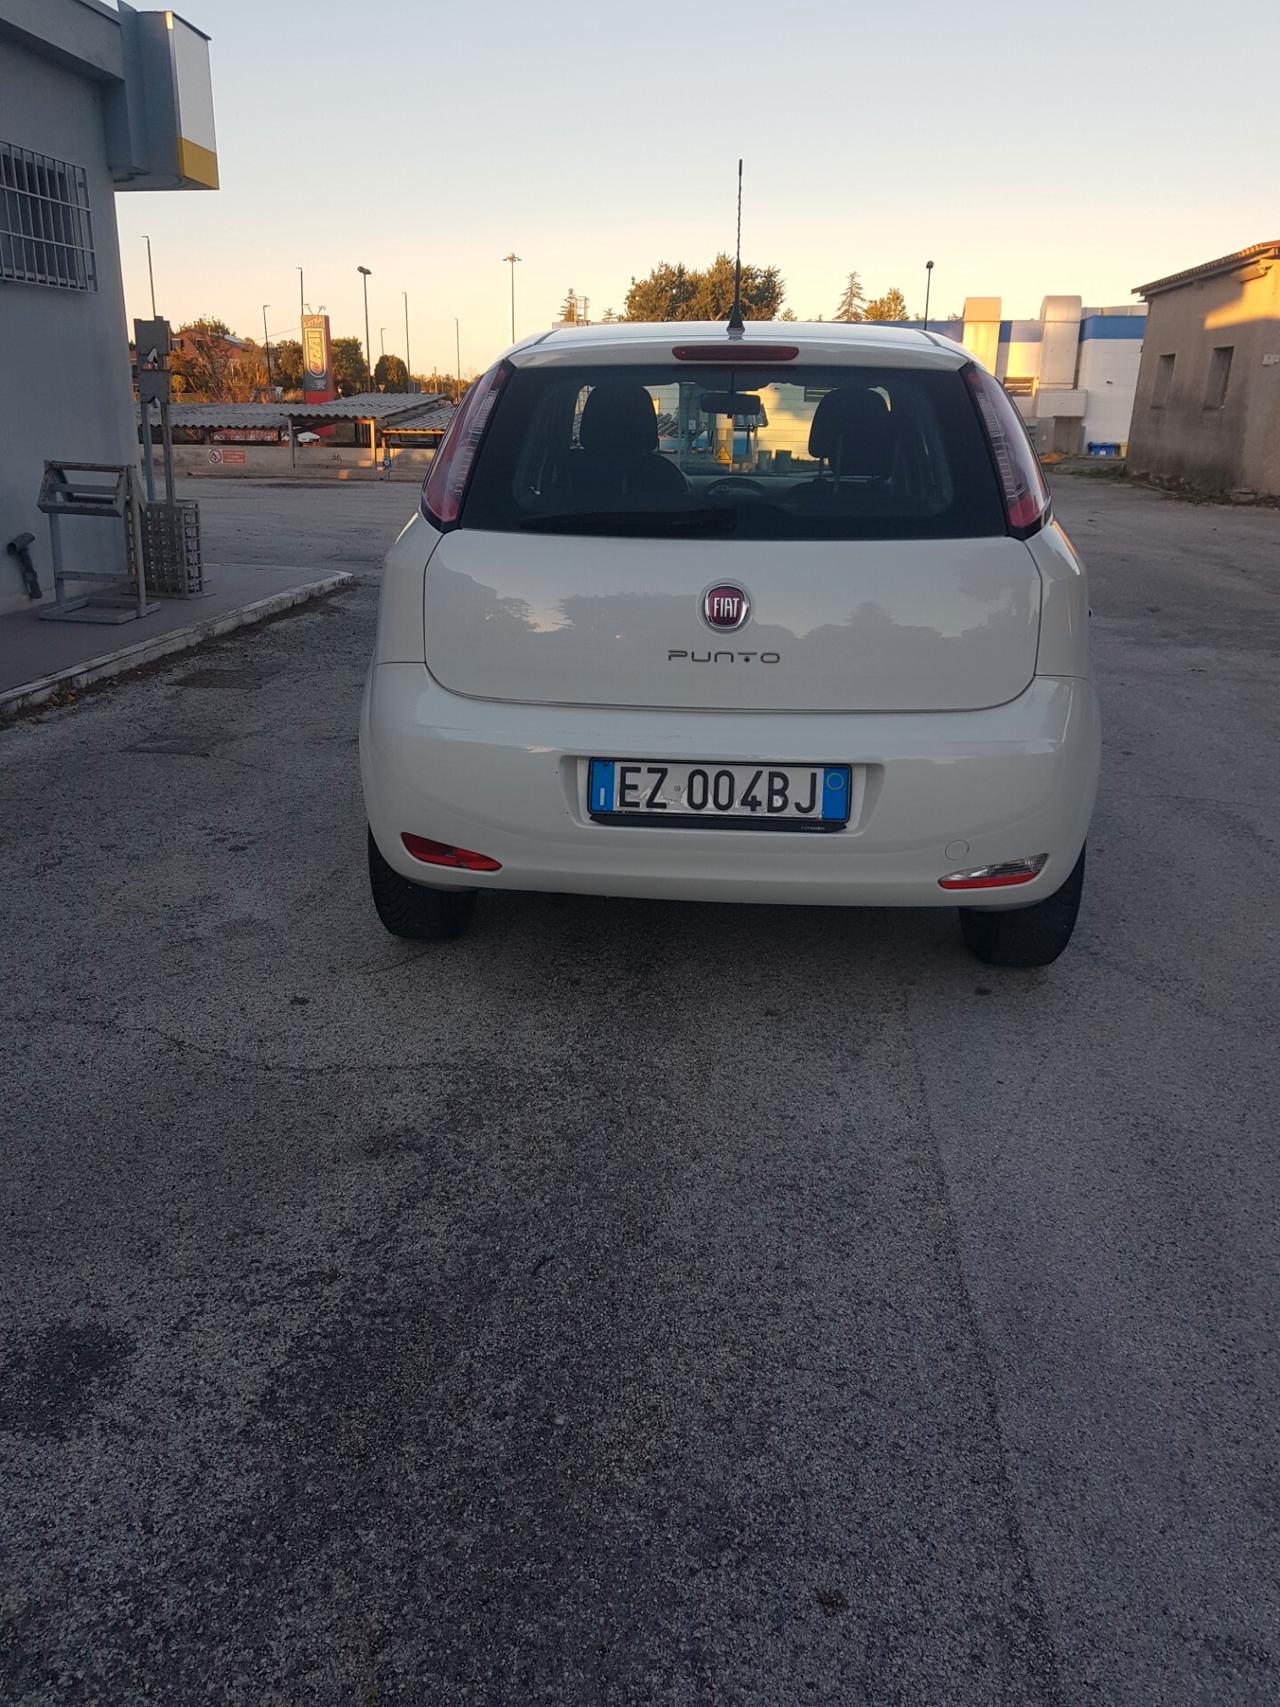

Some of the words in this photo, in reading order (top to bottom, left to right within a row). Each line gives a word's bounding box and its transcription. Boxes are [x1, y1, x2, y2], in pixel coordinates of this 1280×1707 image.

[713, 597, 740, 618] FIAT
[667, 650, 781, 664] PUNTO
[620, 766, 668, 809] EZ
[687, 769, 817, 814] 004BJ
